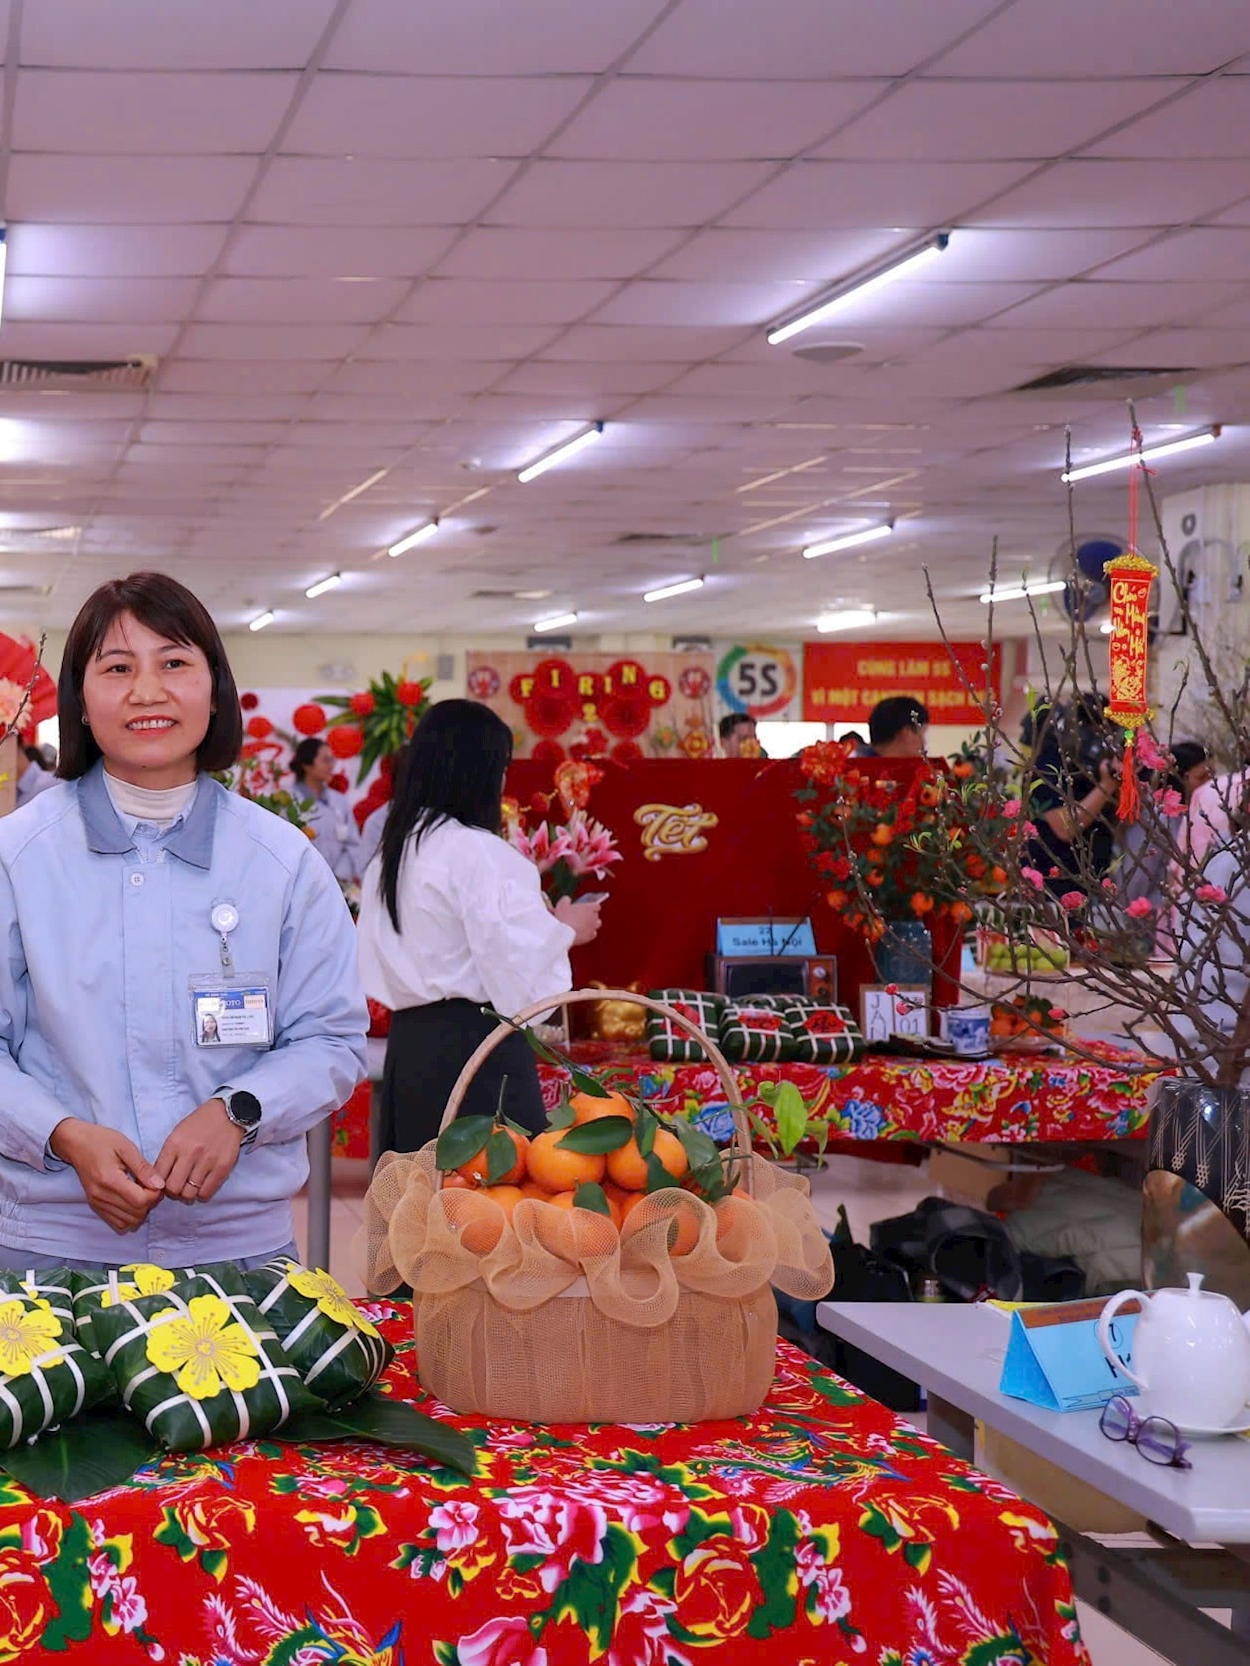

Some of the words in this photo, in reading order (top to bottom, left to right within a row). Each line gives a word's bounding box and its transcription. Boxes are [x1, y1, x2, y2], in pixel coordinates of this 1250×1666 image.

[521, 666, 666, 699] FIRING
[739, 662, 778, 696] 5S
[732, 936, 759, 946] Sale
